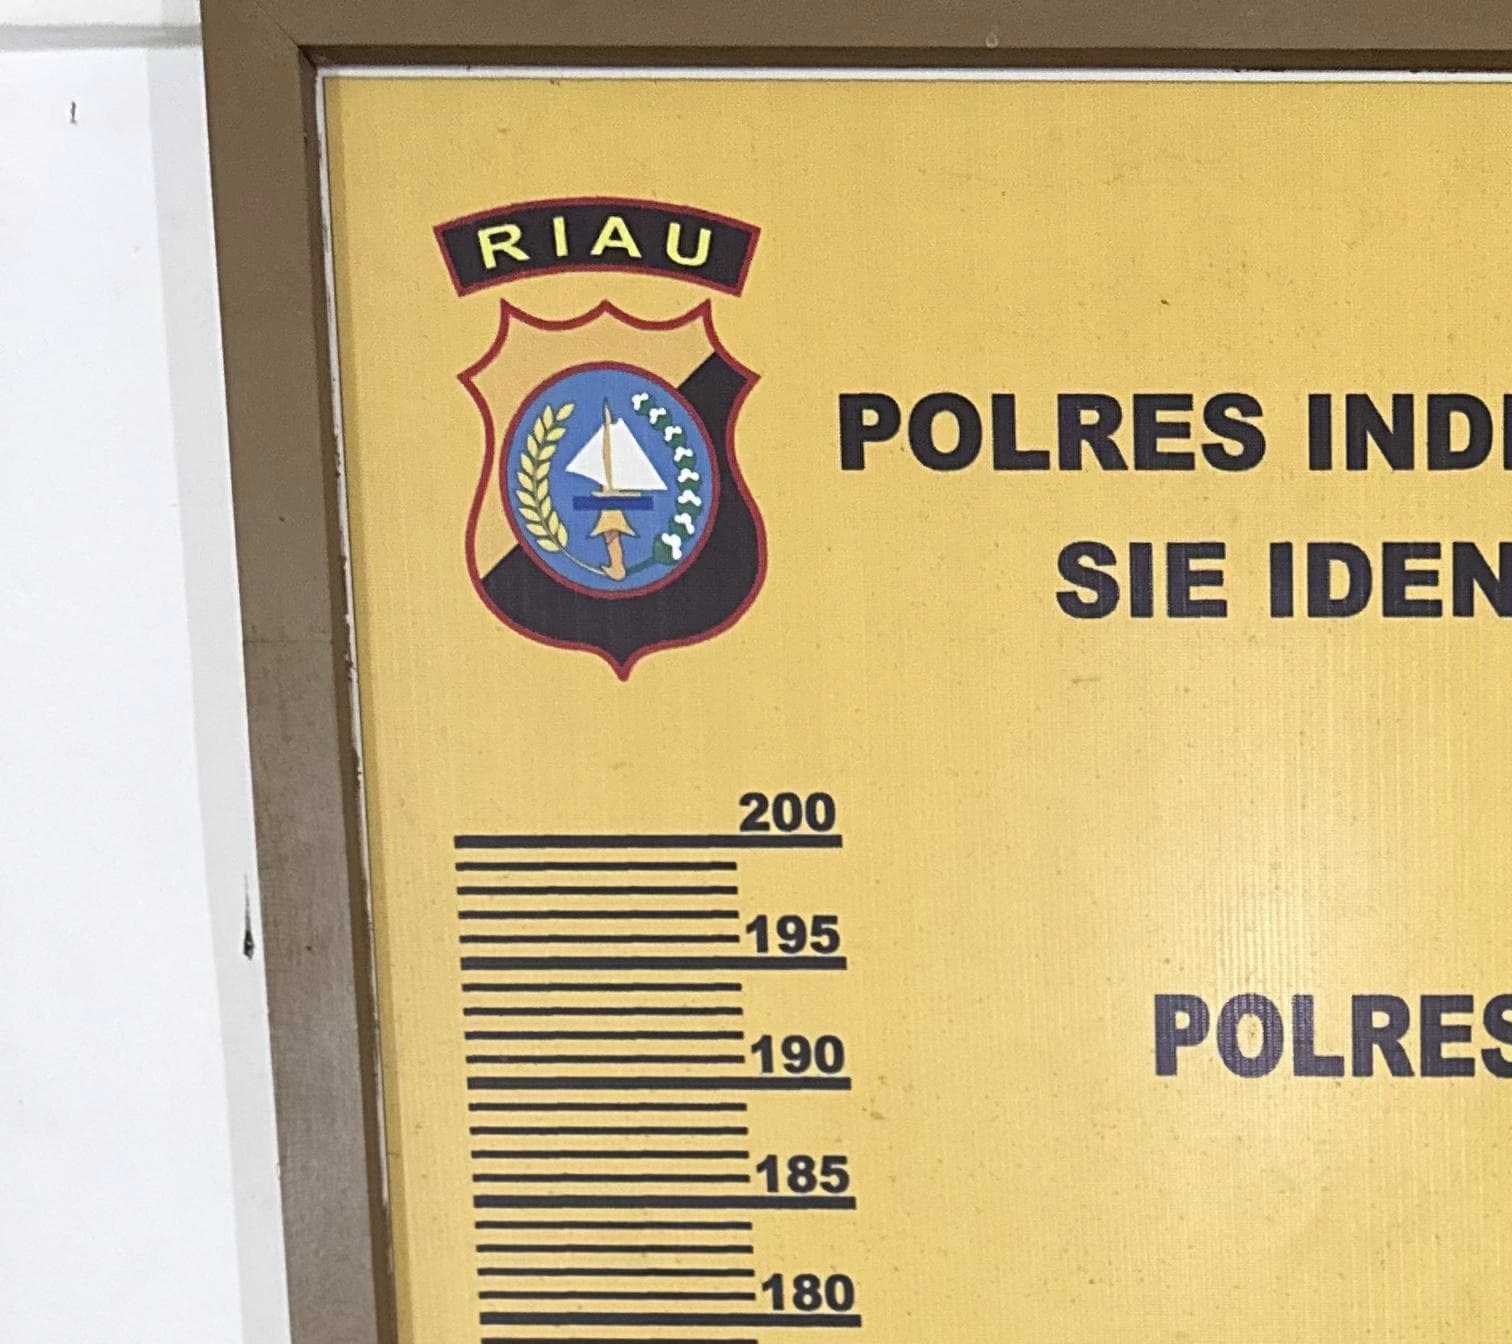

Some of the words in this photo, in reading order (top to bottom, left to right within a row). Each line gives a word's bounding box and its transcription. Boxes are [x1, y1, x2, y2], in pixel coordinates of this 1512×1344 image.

[477, 216, 712, 268] RIAU
[838, 392, 1266, 472] POLRES
[1056, 541, 1228, 619] SIE
[740, 792, 835, 831] 200
[746, 915, 840, 954] 195
[751, 1035, 844, 1074] 190
[757, 1155, 849, 1193] 185
[762, 1273, 854, 1311] 180
